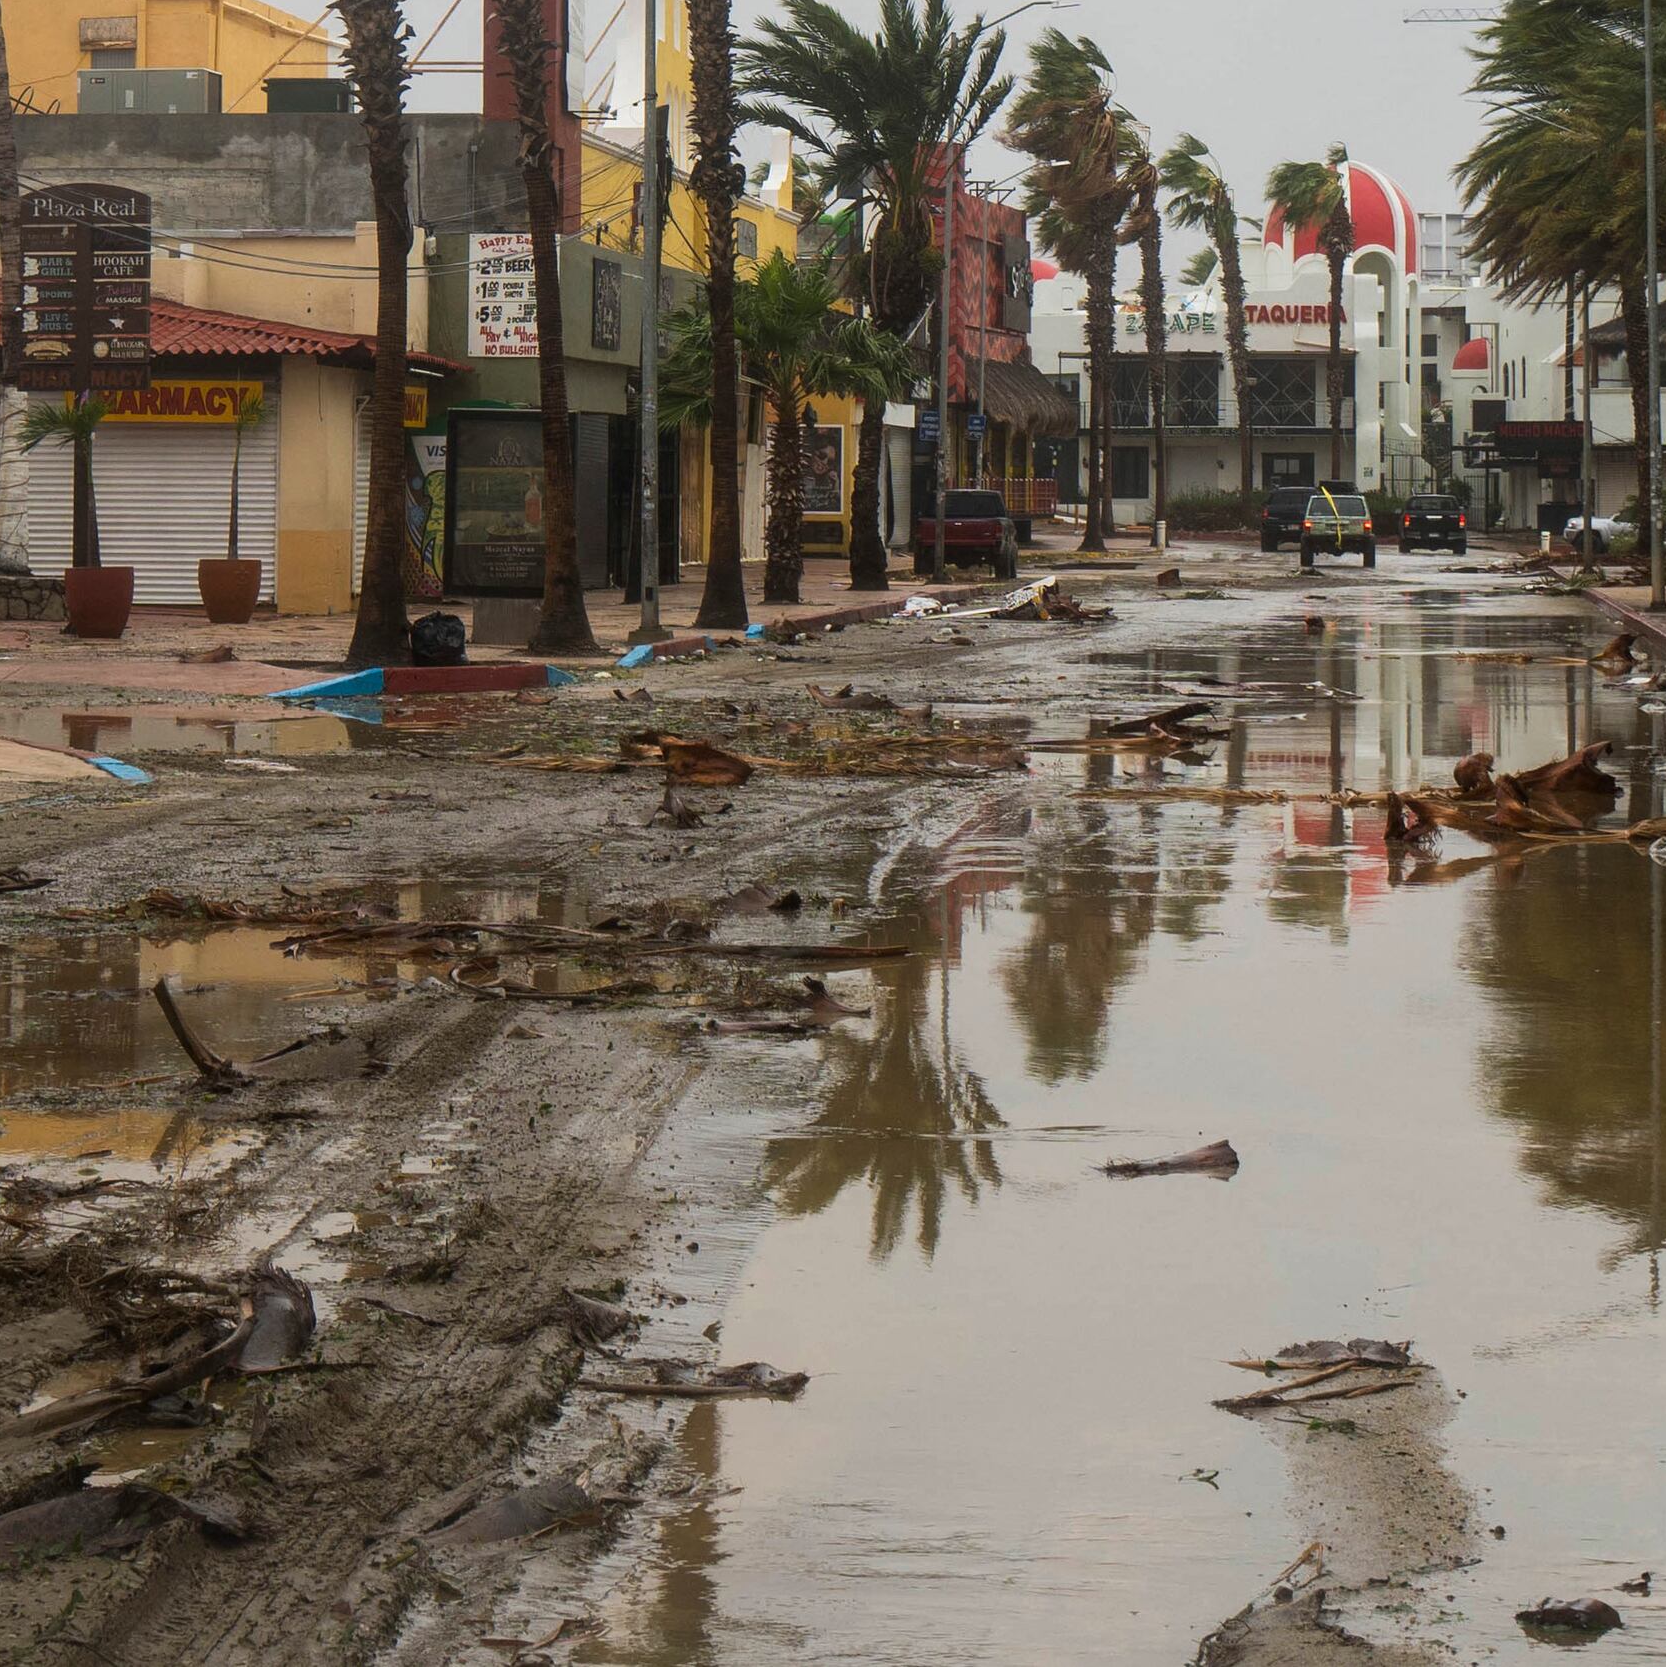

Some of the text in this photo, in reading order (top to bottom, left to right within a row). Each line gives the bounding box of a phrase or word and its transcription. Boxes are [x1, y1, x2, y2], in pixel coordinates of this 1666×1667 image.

[33, 198, 135, 217] Plaza Real
[478, 236, 513, 250] Happy
[93, 256, 144, 266] HOOKAH
[505, 259, 534, 273] BEER!
[40, 267, 73, 276] GRILL
[104, 266, 133, 276] CAFE
[105, 296, 142, 304] MASSAGE
[485, 344, 497, 355] NO
[99, 387, 250, 416] HARMACY
[426, 445, 446, 456] VIS
